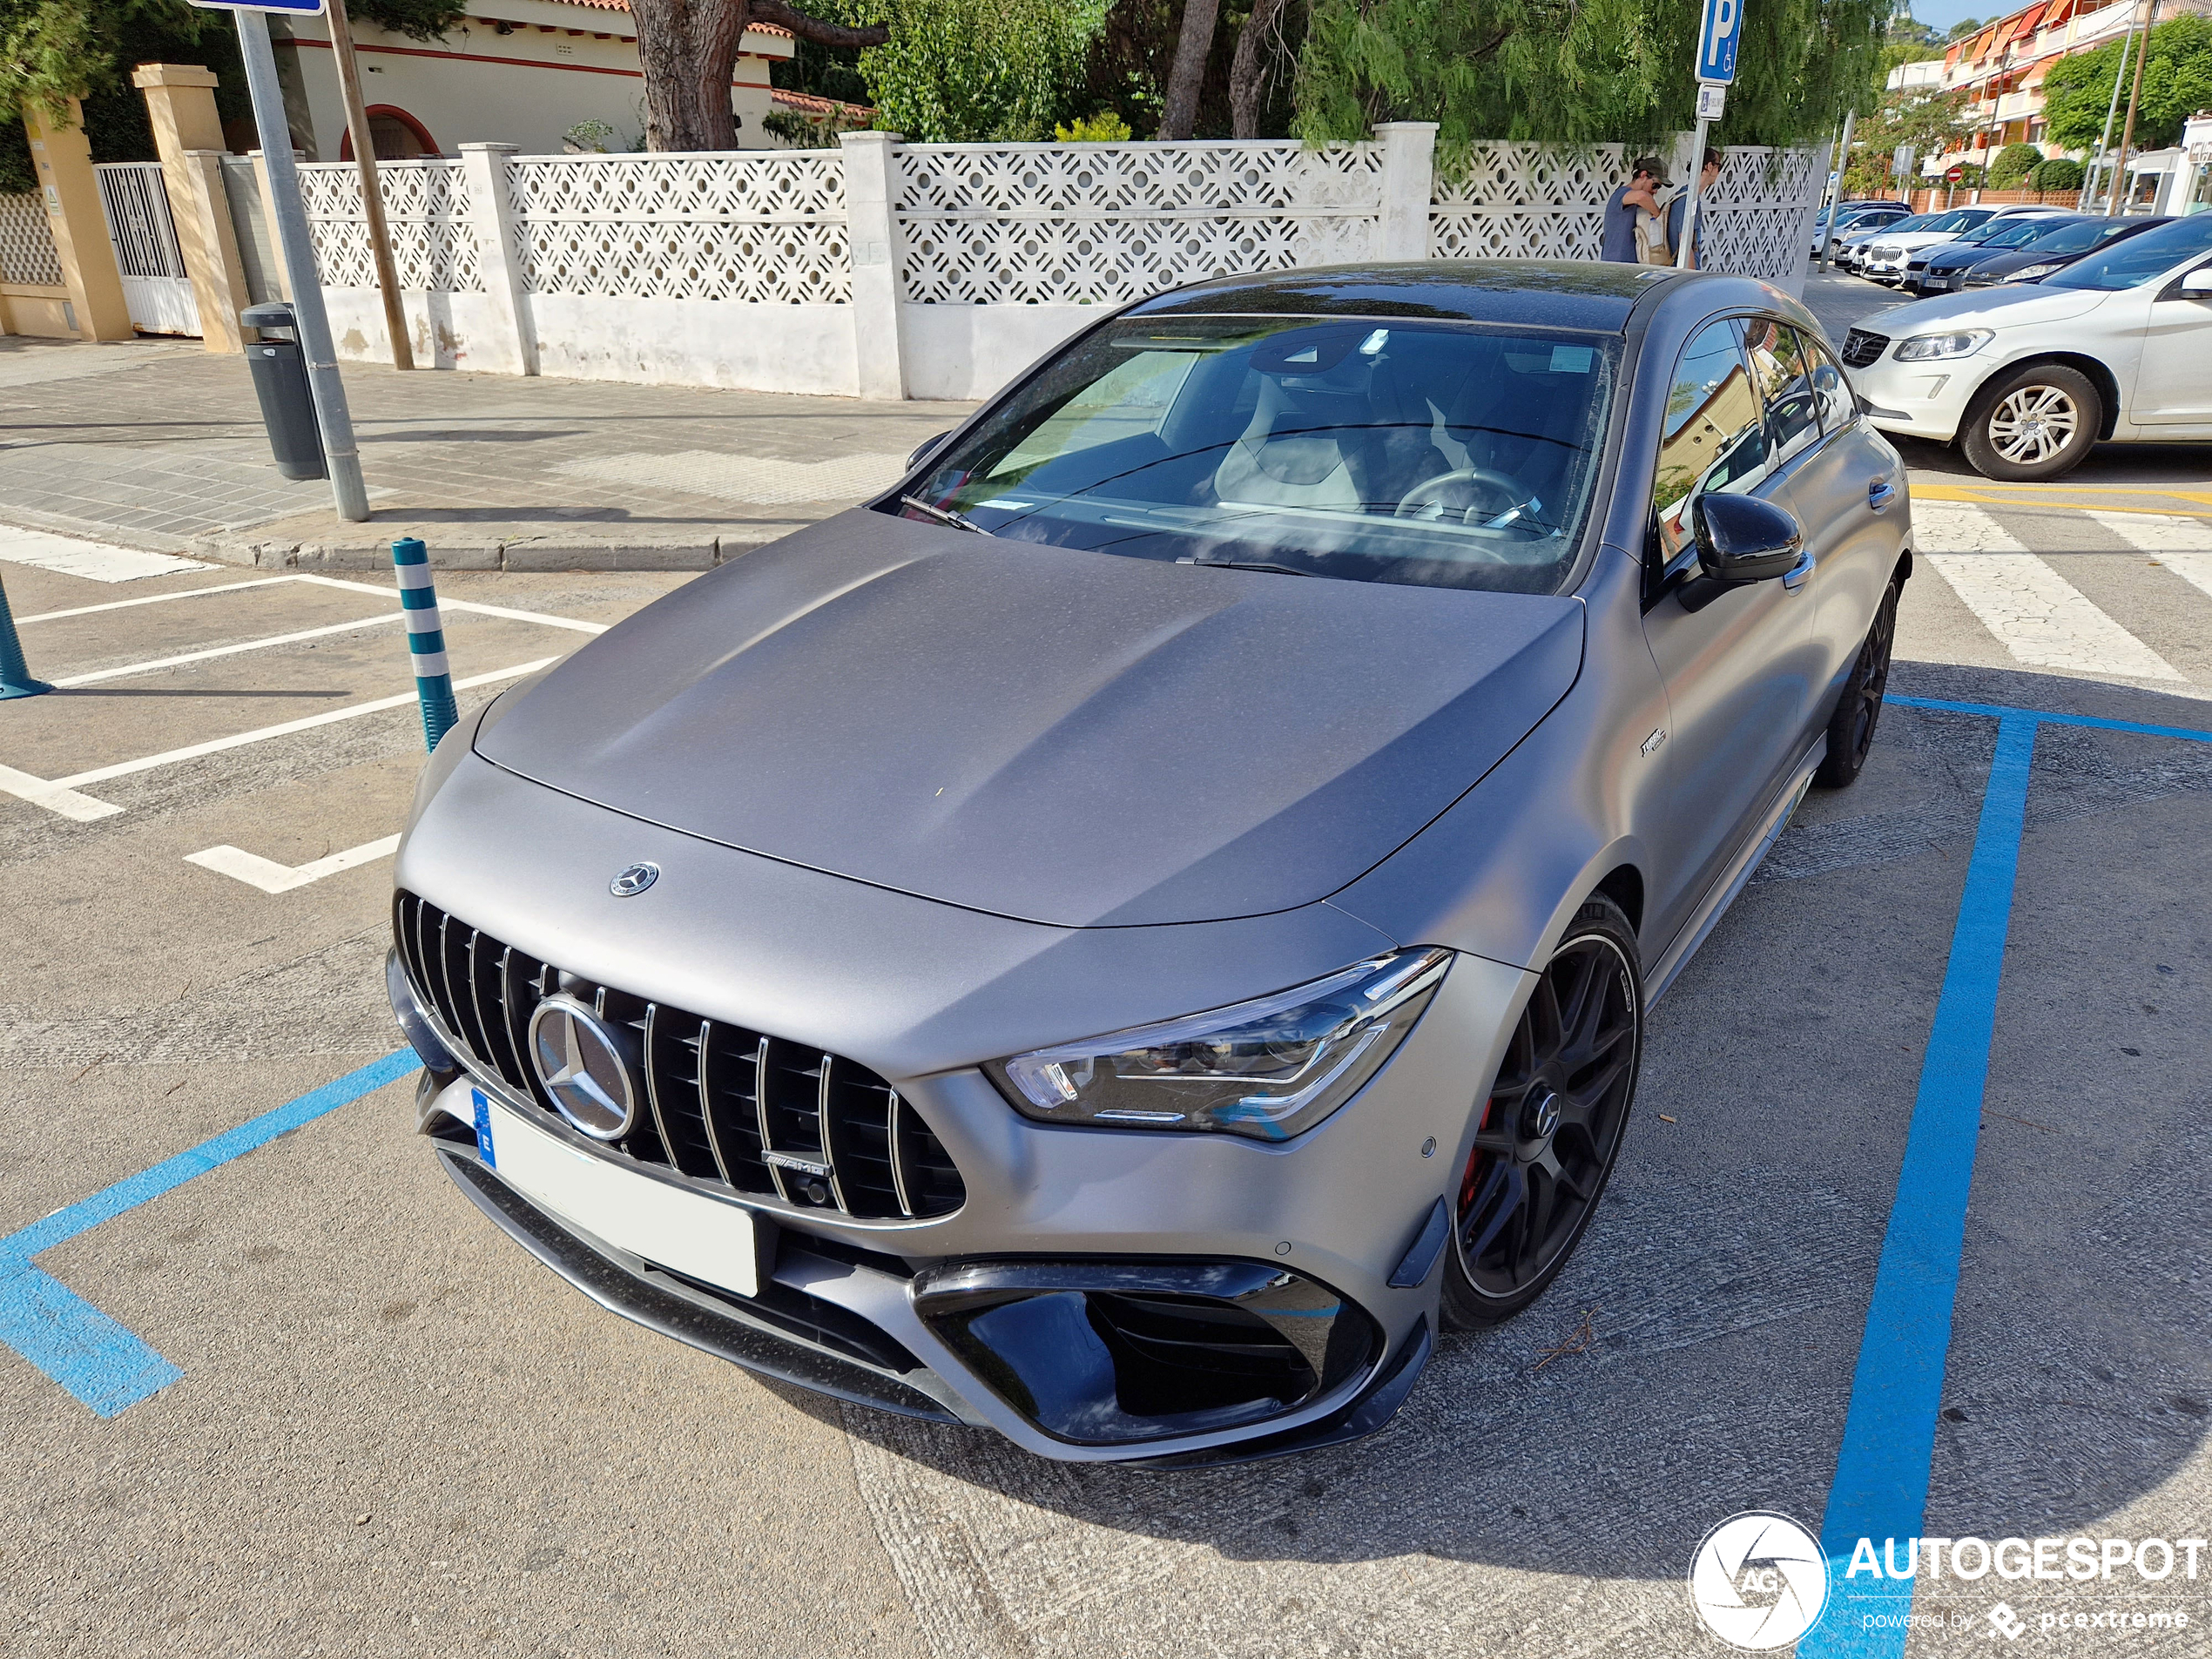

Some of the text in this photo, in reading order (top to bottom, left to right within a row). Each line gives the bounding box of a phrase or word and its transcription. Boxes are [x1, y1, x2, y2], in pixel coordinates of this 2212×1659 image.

[1708, 0, 1737, 66] P
[1640, 728, 1661, 754] TURBO
[482, 1134, 491, 1152] E
[784, 1159, 824, 1176] AMG
